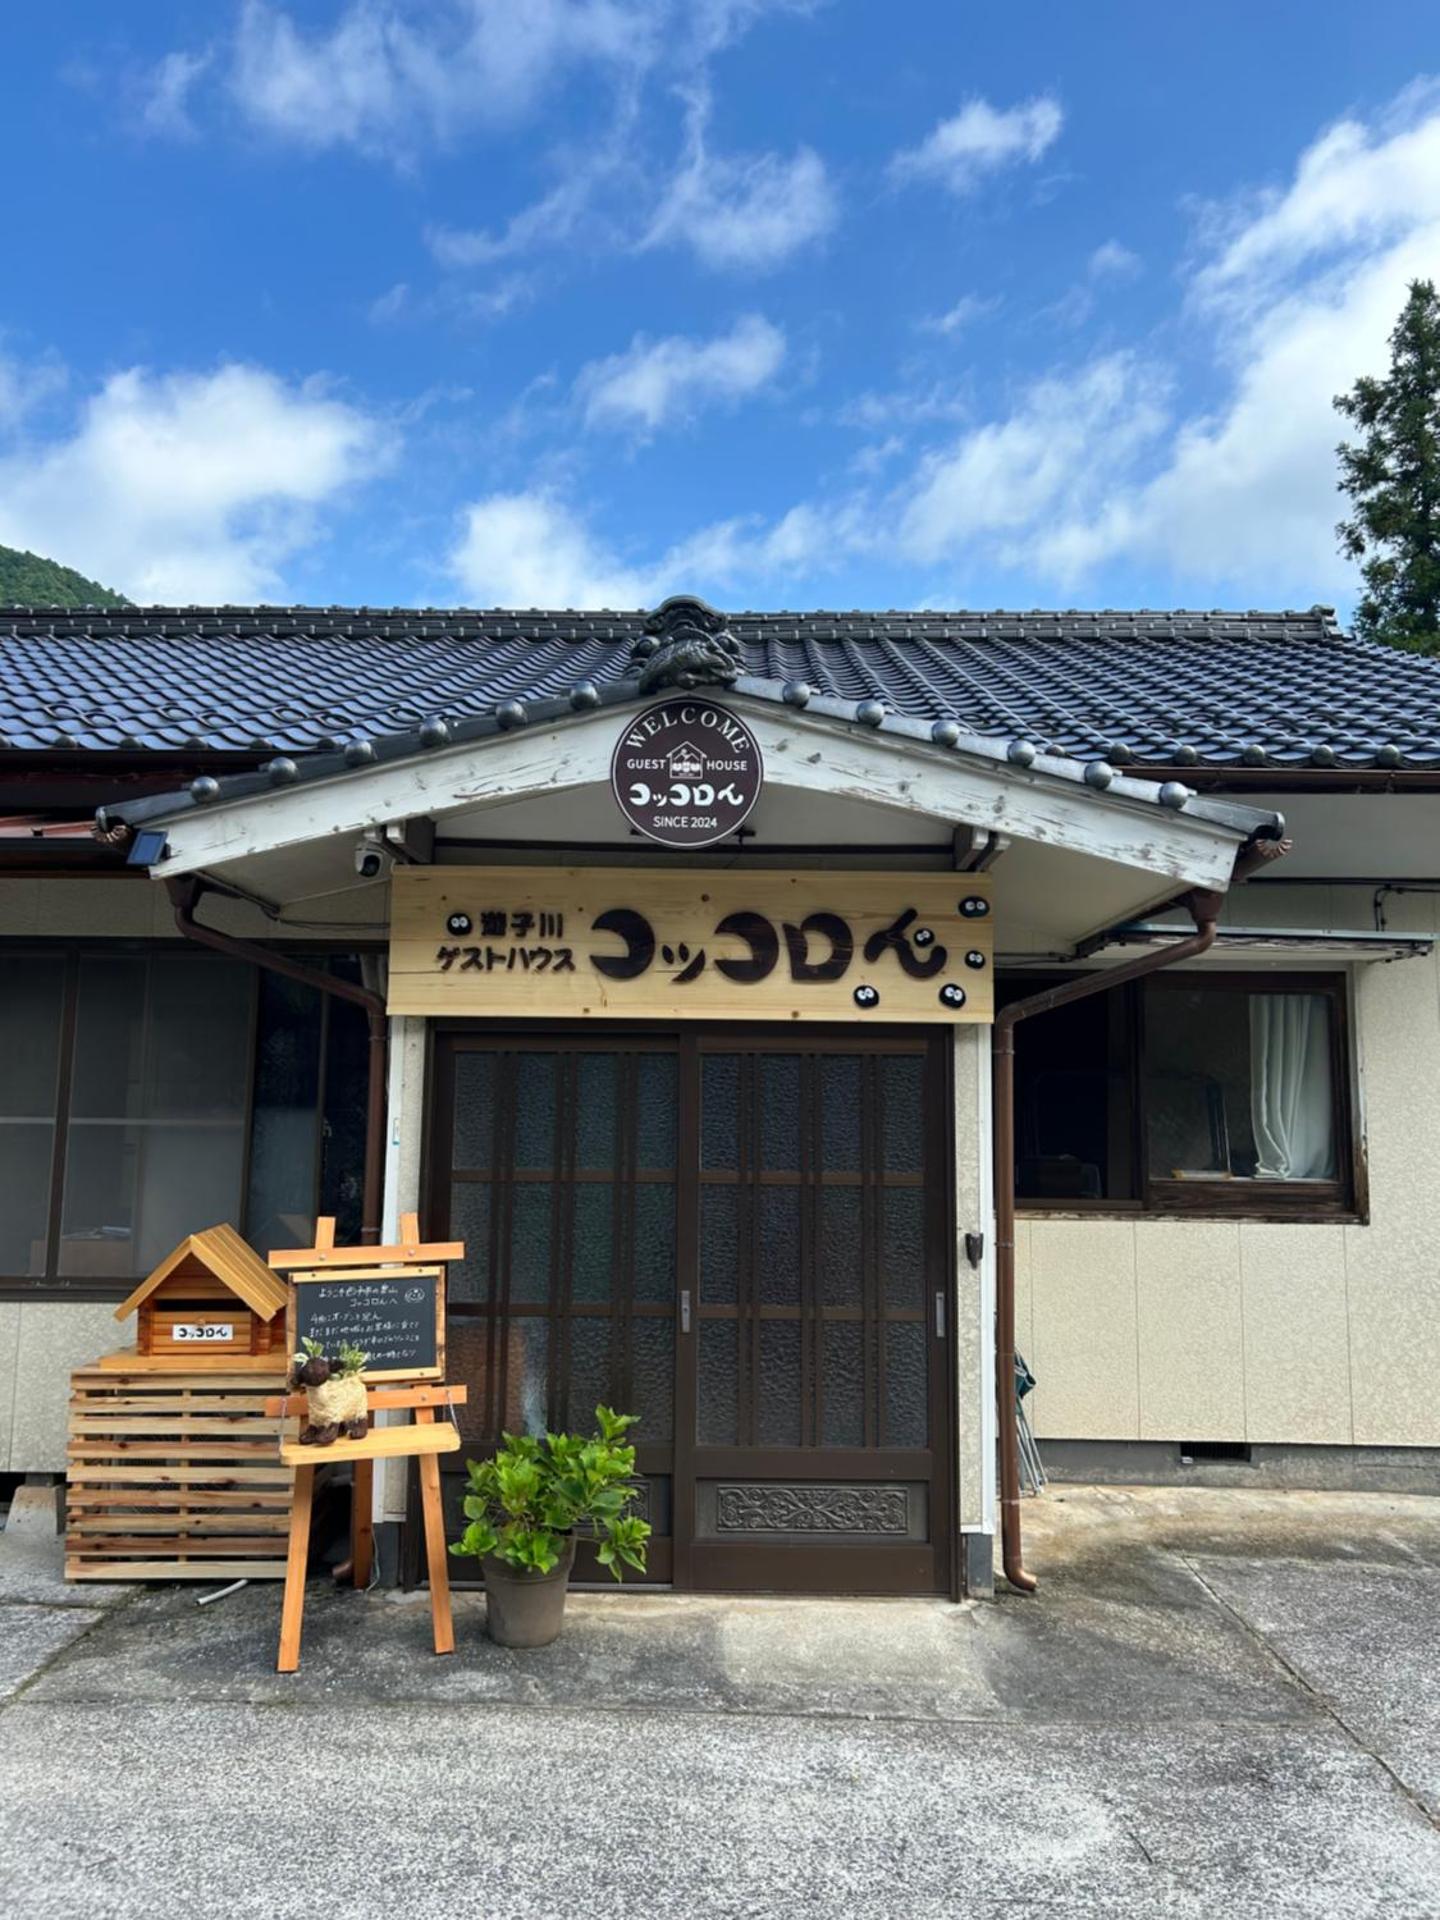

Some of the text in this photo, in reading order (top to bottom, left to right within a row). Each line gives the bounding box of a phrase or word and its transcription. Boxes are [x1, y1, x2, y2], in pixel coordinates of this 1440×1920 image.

[626, 707, 750, 753] WELCOME
[627, 759, 747, 771] GUEST HOUSE
[653, 816, 717, 828] SINCE 2024
[437, 946, 576, 971] ゲストハウス
